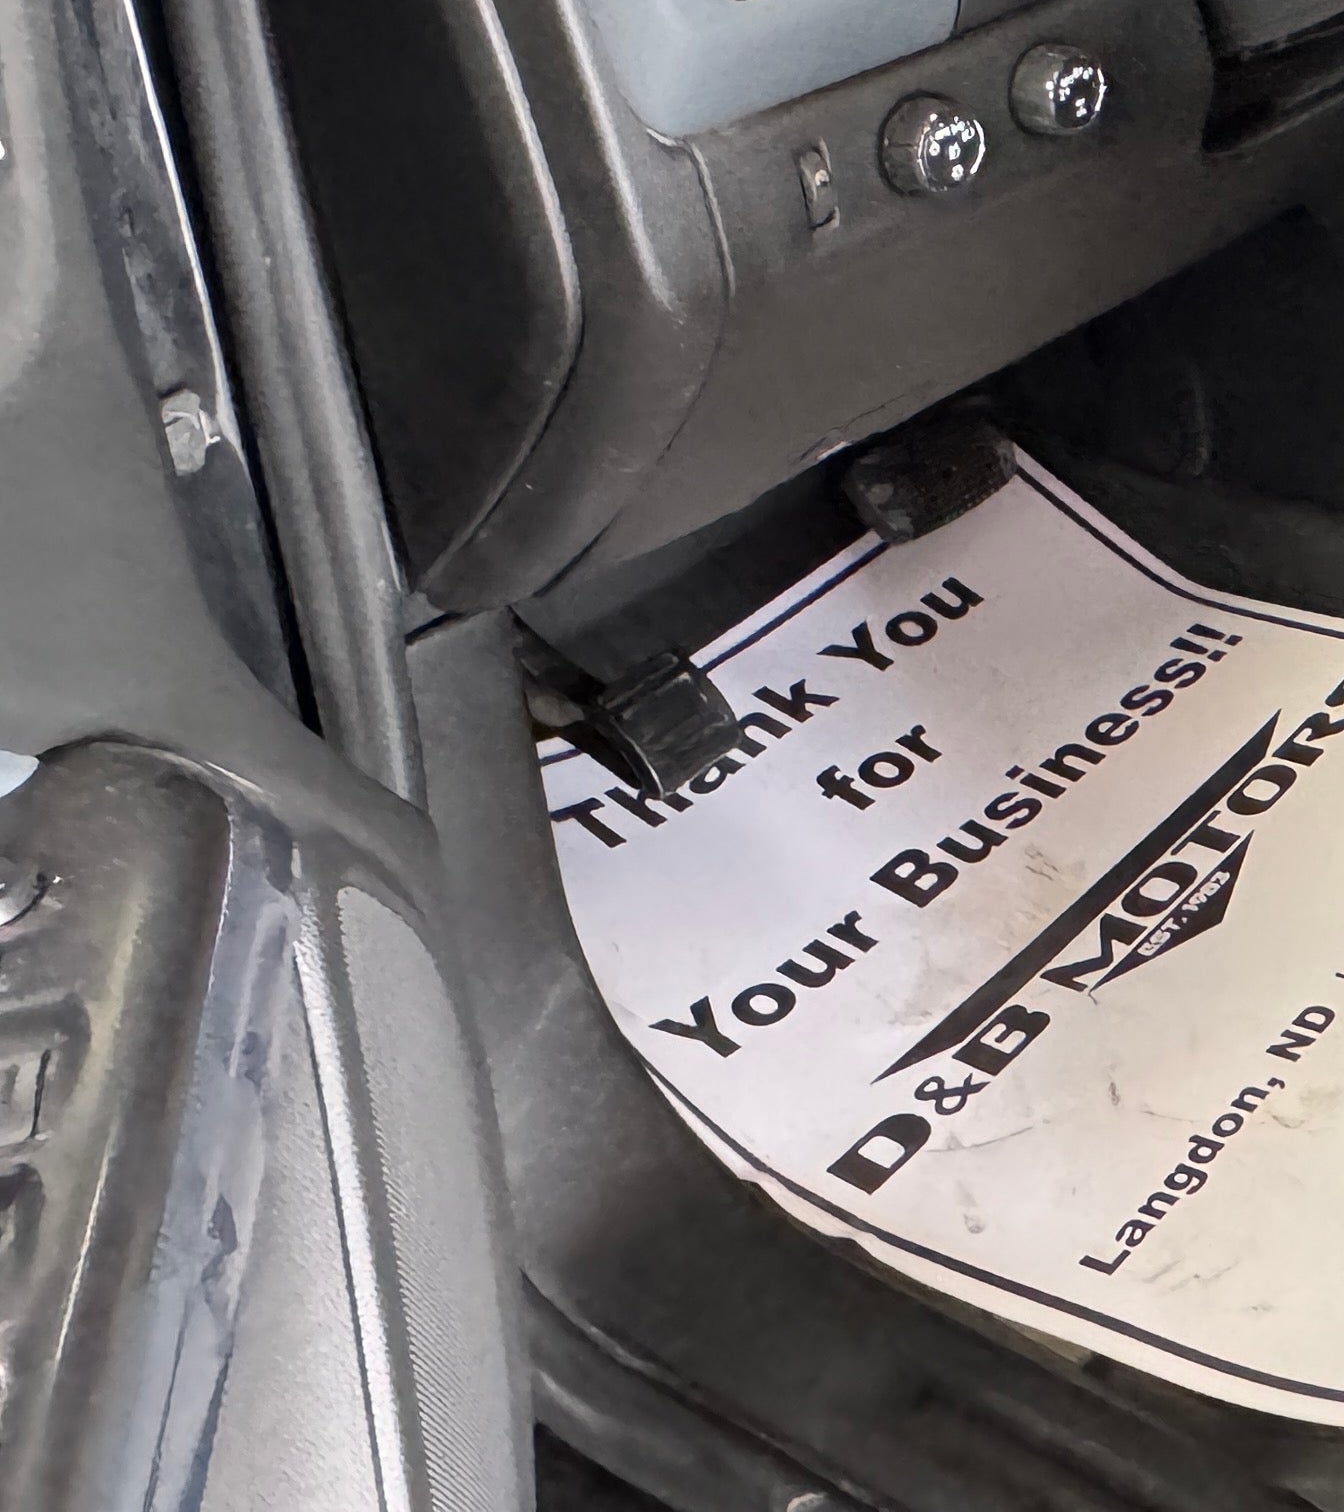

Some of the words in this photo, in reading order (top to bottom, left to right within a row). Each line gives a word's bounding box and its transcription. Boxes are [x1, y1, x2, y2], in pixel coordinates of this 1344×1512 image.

[550, 679, 840, 848] Thank
[817, 576, 985, 672] You
[649, 910, 879, 1058] Your
[870, 623, 1243, 908] Business!!
[816, 724, 943, 811] for
[827, 1004, 1051, 1195] D&B
[1079, 1077, 1285, 1276] Langdon,
[1265, 1006, 1335, 1062] ND
